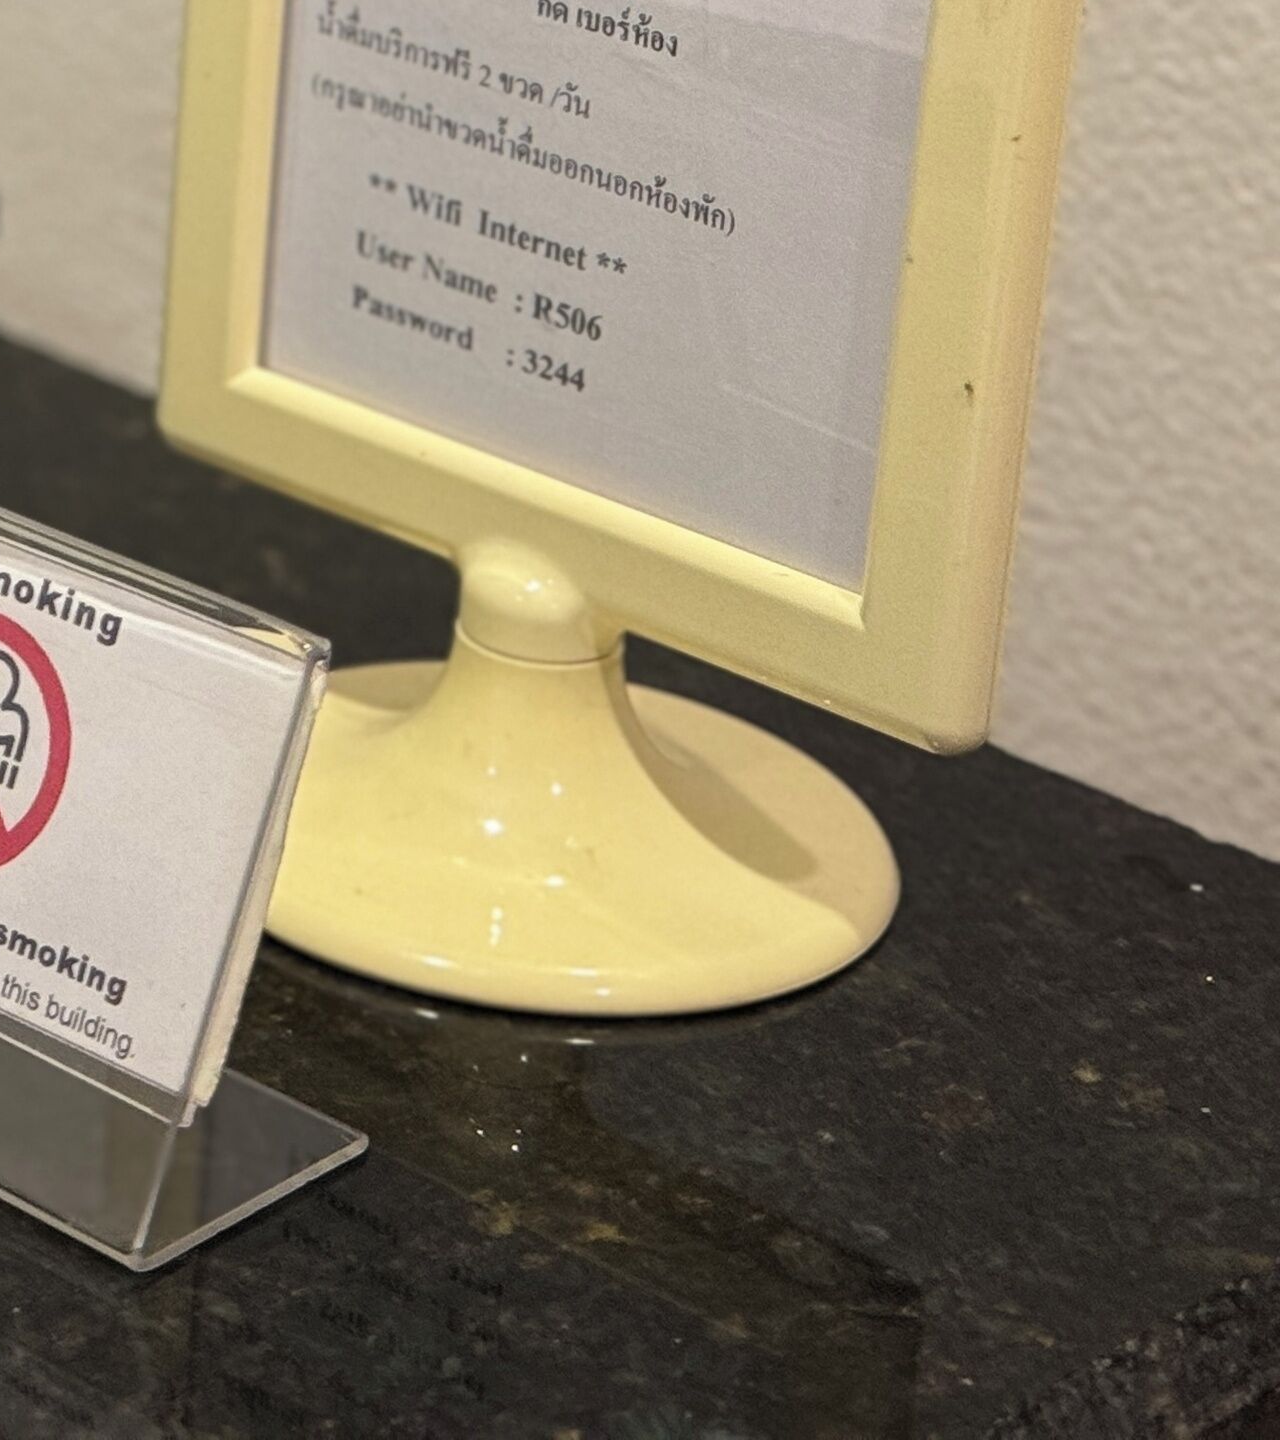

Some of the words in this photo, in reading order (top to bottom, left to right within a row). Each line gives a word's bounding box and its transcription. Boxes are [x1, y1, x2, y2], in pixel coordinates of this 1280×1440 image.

[575, 4, 679, 58] เบอร์ห้อง
[478, 63, 492, 89] 2
[498, 72, 544, 105] ขวด
[406, 183, 463, 227] Wifi
[477, 208, 588, 272] Internet
[356, 230, 415, 272] User
[422, 253, 498, 304] Name
[532, 292, 604, 342] R506
[352, 284, 474, 352] Password
[520, 348, 586, 393] 3244
[0, 973, 42, 1012] this
[43, 993, 136, 1061] building.
